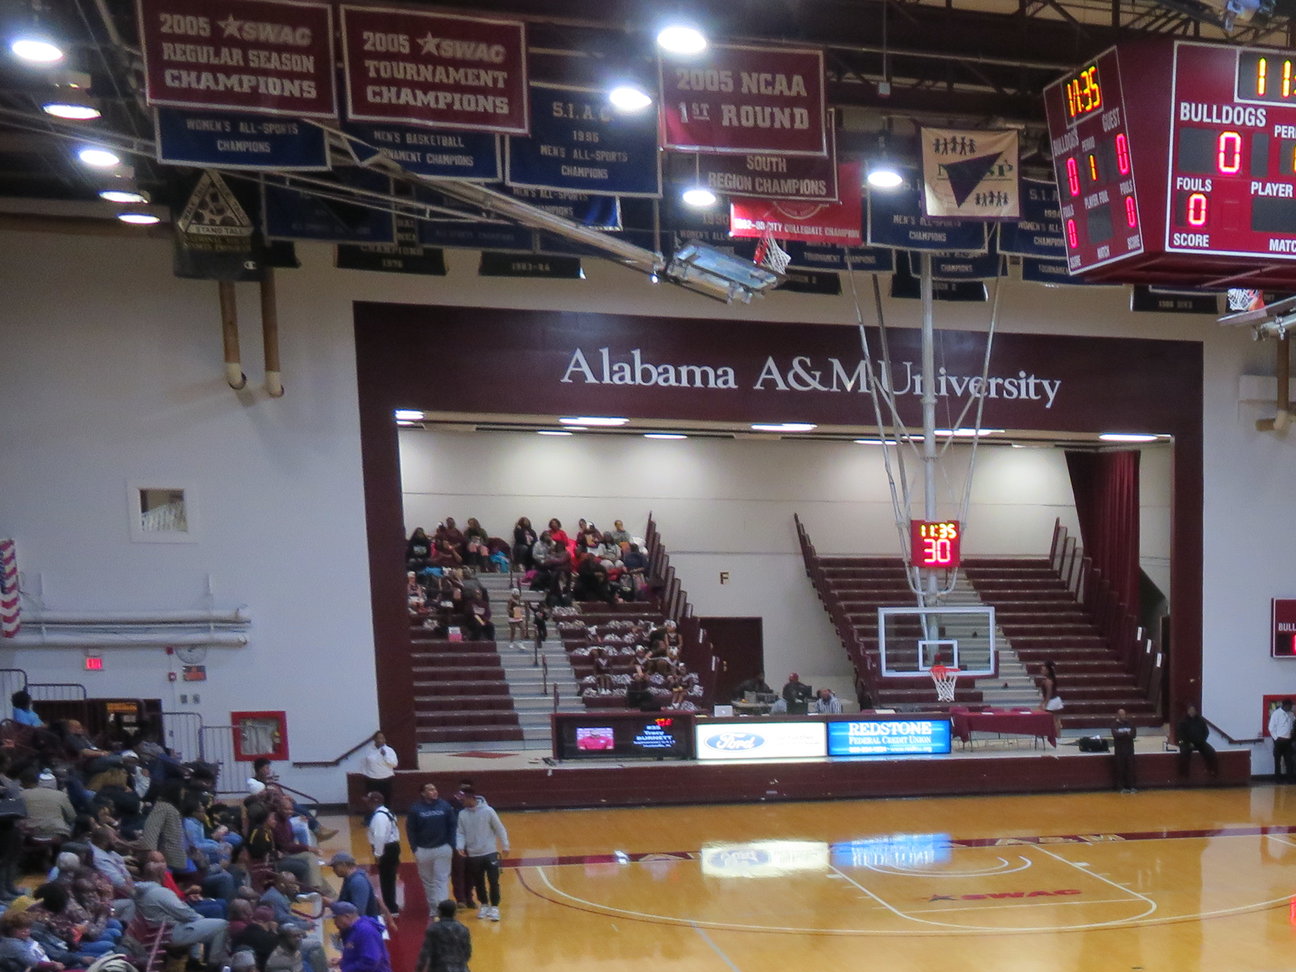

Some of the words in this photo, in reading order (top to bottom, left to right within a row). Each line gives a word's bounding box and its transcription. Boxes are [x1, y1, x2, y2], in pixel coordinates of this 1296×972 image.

[159, 13, 211, 37] 2005
[241, 22, 312, 47] SWAC
[162, 42, 245, 66] REGULAR
[248, 50, 315, 73] SEASON
[362, 31, 410, 54] 2005
[439, 40, 506, 64] SWAC
[164, 69, 317, 99] CHAMPIONS
[364, 60, 508, 88] TOURNAMENT
[676, 68, 735, 93] 2005
[740, 72, 808, 97] NCAA
[366, 85, 510, 114] CHAMPIONS
[721, 103, 809, 130] ROUND
[1102, 107, 1121, 132] GUEST
[1179, 102, 1267, 127] BULLDOGS
[217, 140, 271, 153] CHAMPIONS
[406, 134, 465, 148] BASKETBALL
[1218, 131, 1242, 174] 0
[427, 152, 474, 167] CHAMPIONS
[747, 155, 787, 172] SOUTH
[561, 165, 608, 179] CHAMPIONS
[708, 174, 751, 190] REGION
[755, 177, 827, 195] CHAMPIONS
[1176, 177, 1212, 192] FOULS
[1251, 181, 1293, 198] PLAYER
[1189, 193, 1207, 226] 0
[1173, 233, 1210, 247] SCORE
[561, 347, 738, 390] Alabama
[753, 355, 869, 393] A&M
[921, 523, 957, 538] 11:35
[924, 538, 951, 562] 30
[720, 571, 730, 585] F
[848, 721, 932, 736] REDSTONE
[716, 733, 756, 750] Ford
